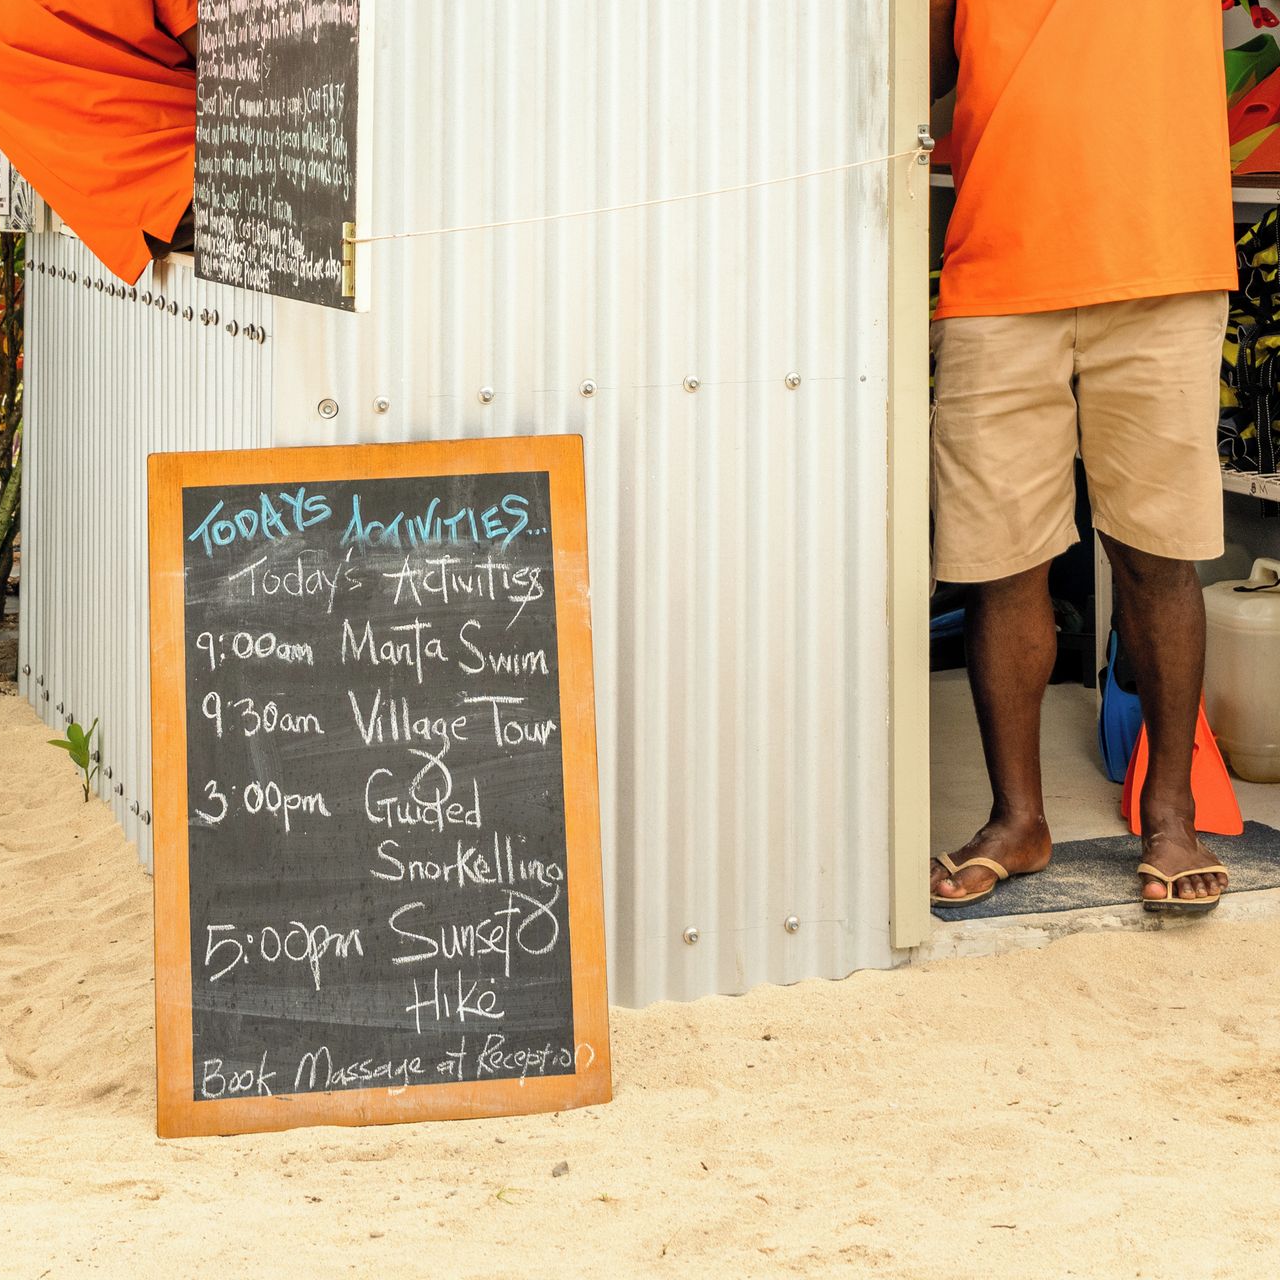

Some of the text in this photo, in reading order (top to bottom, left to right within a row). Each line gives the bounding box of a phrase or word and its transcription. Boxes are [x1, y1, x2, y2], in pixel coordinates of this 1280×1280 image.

[188, 486, 334, 558] TODAYS
[228, 546, 364, 614] Today's
[195, 618, 550, 685] 9:00am Manta Swim
[347, 688, 470, 780] Village
[461, 694, 558, 747] Tour
[195, 768, 483, 832] 3:00pm Guided
[205, 891, 521, 992] 5:00pm Sunset
[405, 969, 506, 1035] Hike
[200, 1033, 596, 1099] Book Massage at Reception
